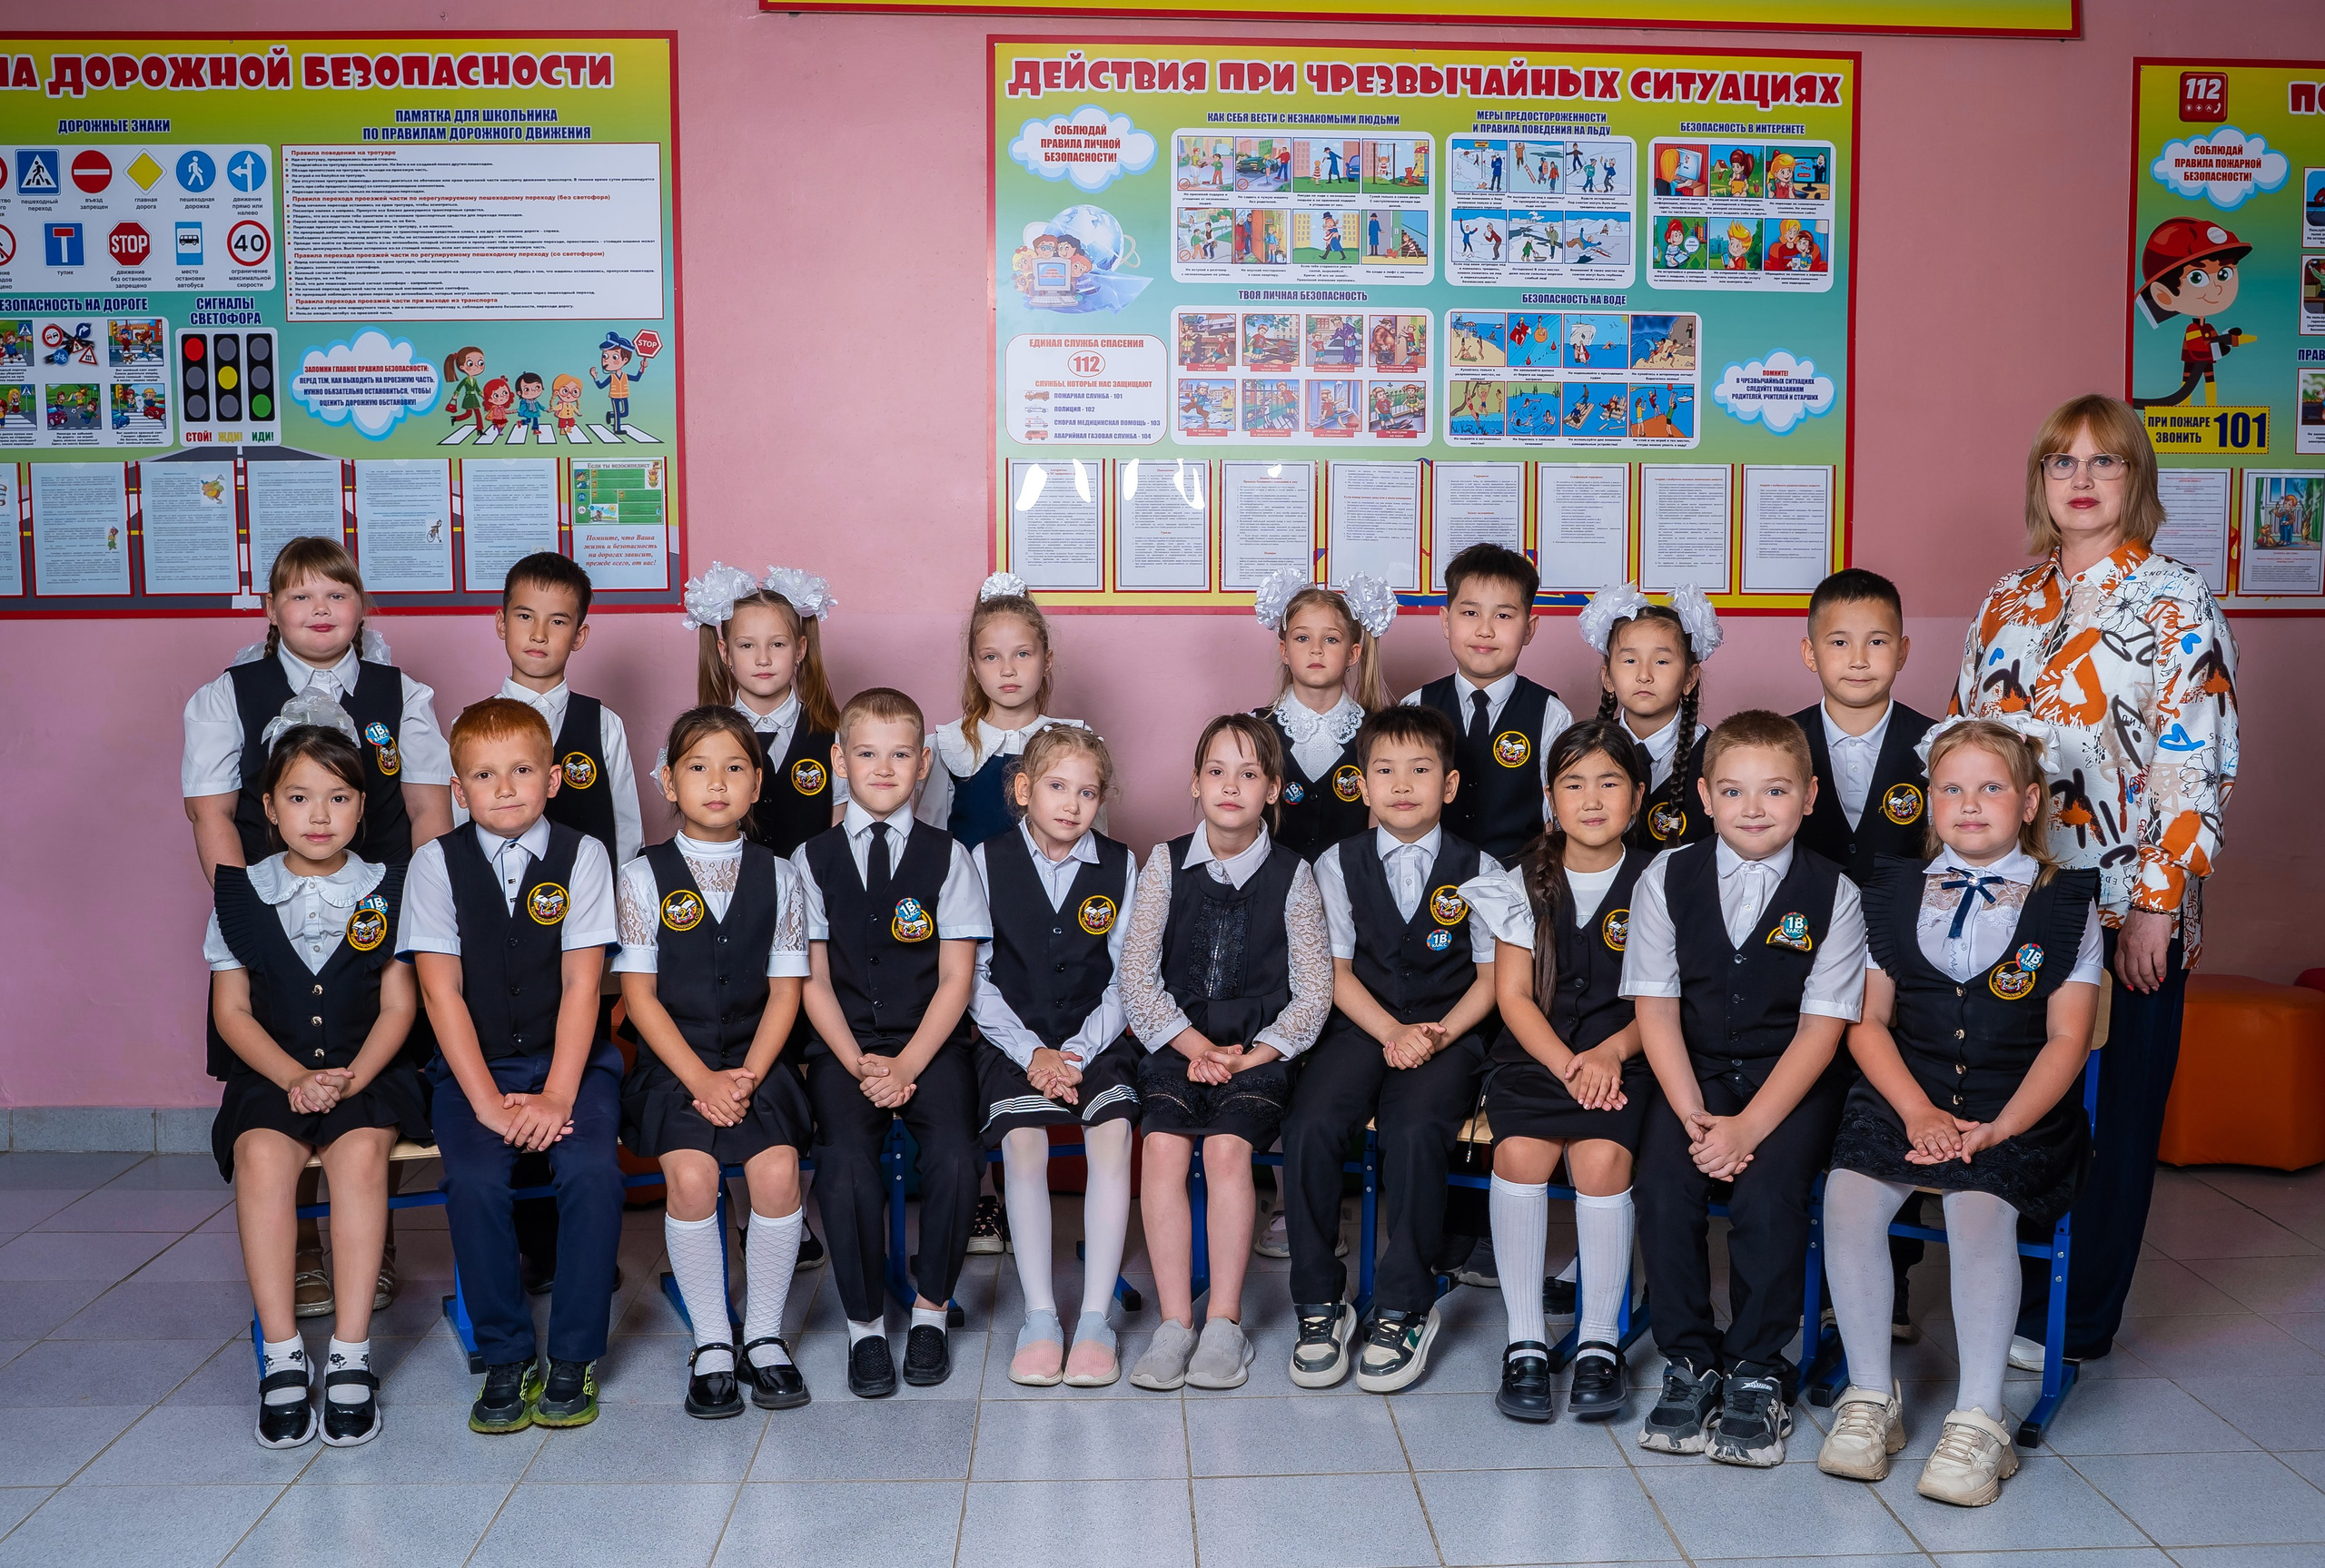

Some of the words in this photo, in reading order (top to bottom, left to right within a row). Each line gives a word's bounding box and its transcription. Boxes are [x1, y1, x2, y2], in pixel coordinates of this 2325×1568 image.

[47, 46, 292, 96] ДОРОЖНОЙ
[303, 54, 614, 88] БЕЗОПАСНОСТИ
[1007, 52, 1208, 96] ДЕЙСТВИЯ
[1219, 62, 1295, 93] ПРИ
[1306, 60, 1620, 100] ЧРЕЗВЫЧАЙНЫХ
[1630, 70, 1842, 110] СИТУАЦИЯХ
[2185, 78, 2221, 100] 112
[396, 110, 451, 122] ПАМЯТКА
[454, 110, 479, 123] ДЛЯ
[482, 109, 558, 122] ШКОЛЬНИКА
[1207, 113, 1225, 122] КАК
[1226, 113, 1249, 123] СЕБЯ
[1251, 113, 1278, 123] ВЕСТИ
[1280, 113, 1285, 123] С
[1287, 113, 1356, 124] НЕЗНАКОМЫМИ
[1358, 115, 1400, 125] ЛЮДЬМИ
[1477, 111, 1503, 121] МЕРЫ
[1505, 112, 1607, 123] ПРЕДОСТОРОЖЕННОСТИ
[58, 120, 128, 134] ДОРОЖНЫЕ
[132, 120, 171, 133] ЗНАКИ
[1054, 123, 1107, 136] СОБЛЮДАЙ
[1473, 123, 1478, 133] И
[1480, 123, 1519, 133] ПРАВИЛА
[1522, 124, 1572, 135] ПОВЕДЕНИЯ
[1574, 125, 1585, 134] НА
[1587, 126, 1611, 136] ЛЬДУ
[1680, 123, 1746, 133] БЕЗОПАСНОСТЬ
[1748, 124, 1754, 133] В
[1756, 124, 1805, 134] ИНТЕРЕНЕТЕ
[362, 127, 379, 140] ПО
[381, 127, 446, 140] ПРАВИЛАМ
[449, 127, 521, 142] ДОРОЖНОГО
[525, 126, 590, 141] ДВИЖЕНИЯ
[1041, 138, 1083, 149] ПРАВИЛА
[1083, 137, 1121, 150] ЛИЧНОЙ
[2194, 144, 2243, 156] СОБЛЮДАЙ
[1044, 152, 1118, 163] БЕЗОПАСНОСТИ!
[2174, 159, 2213, 168] ПРАВИЛА
[2215, 158, 2261, 169] ПОЖАРНОЙ
[2184, 172, 2252, 182] БЕЗОПАСНОСТИ!
[111, 234, 148, 253] STOP
[233, 234, 265, 252] 40
[1239, 291, 1261, 300] ТВОЯ
[1262, 291, 1298, 300] ЛИЧНАЯ
[1300, 291, 1368, 301] БЕЗОПАСНОСТЬ
[1522, 294, 1588, 304] БЕЗОПАСНОСТЬ
[1590, 295, 1601, 304] НА
[1604, 295, 1626, 305] ВОДЕ
[85, 299, 101, 311] НА
[103, 298, 148, 312] ДОРОГЕ
[196, 297, 254, 310] СИГНАЛЫ
[191, 312, 262, 324] СВЕТОФОРА
[638, 339, 658, 349] STOP
[1029, 339, 1062, 349] ЕДИНАЯ
[1064, 339, 1099, 348] СЛУЖБА
[1101, 339, 1143, 348] СПАСЕНИЯ
[1073, 356, 1100, 372] 112
[2148, 417, 2167, 427] ПРИ
[2170, 417, 2211, 427] ПОЖАРЕ
[186, 430, 213, 442] СТОЙ!
[2213, 412, 2266, 448] 101
[218, 432, 242, 443] ЖДИ!
[252, 431, 274, 443] ИДИ!
[2156, 432, 2201, 443] ЗВОНИТЬ
